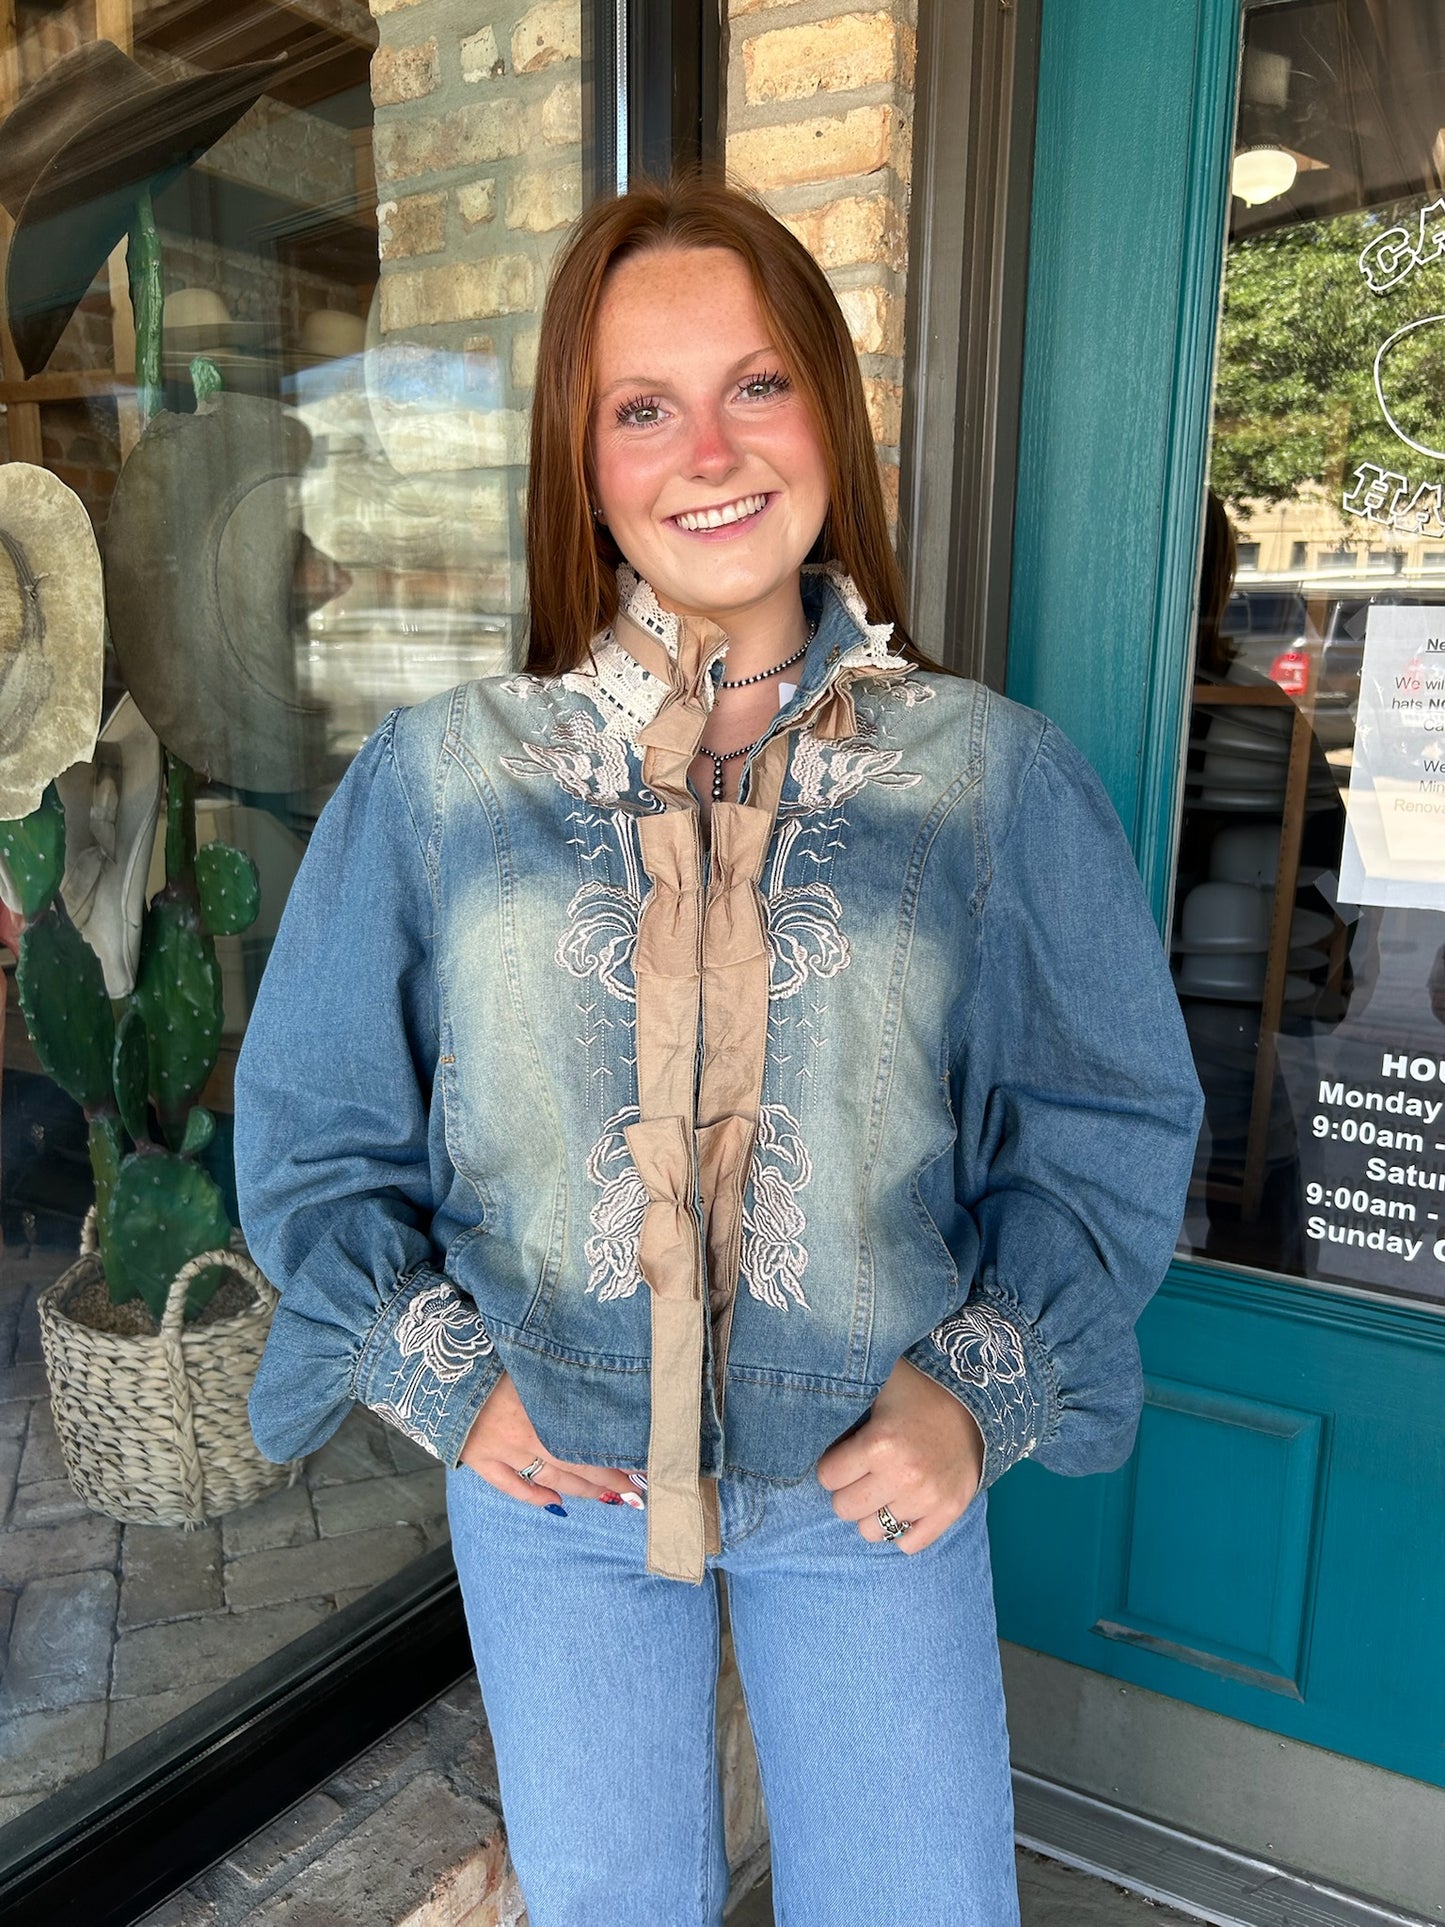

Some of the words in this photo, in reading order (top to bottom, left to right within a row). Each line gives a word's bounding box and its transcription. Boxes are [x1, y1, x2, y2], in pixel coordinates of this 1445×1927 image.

[1395, 676, 1420, 690] We
[1392, 697, 1422, 710] hats
[1429, 698, 1445, 710] N
[1318, 1081, 1443, 1124] Monday
[1312, 1115, 1423, 1152] 9:00am
[1306, 1183, 1416, 1221] 9:00am
[1306, 1216, 1423, 1261] Sunday
